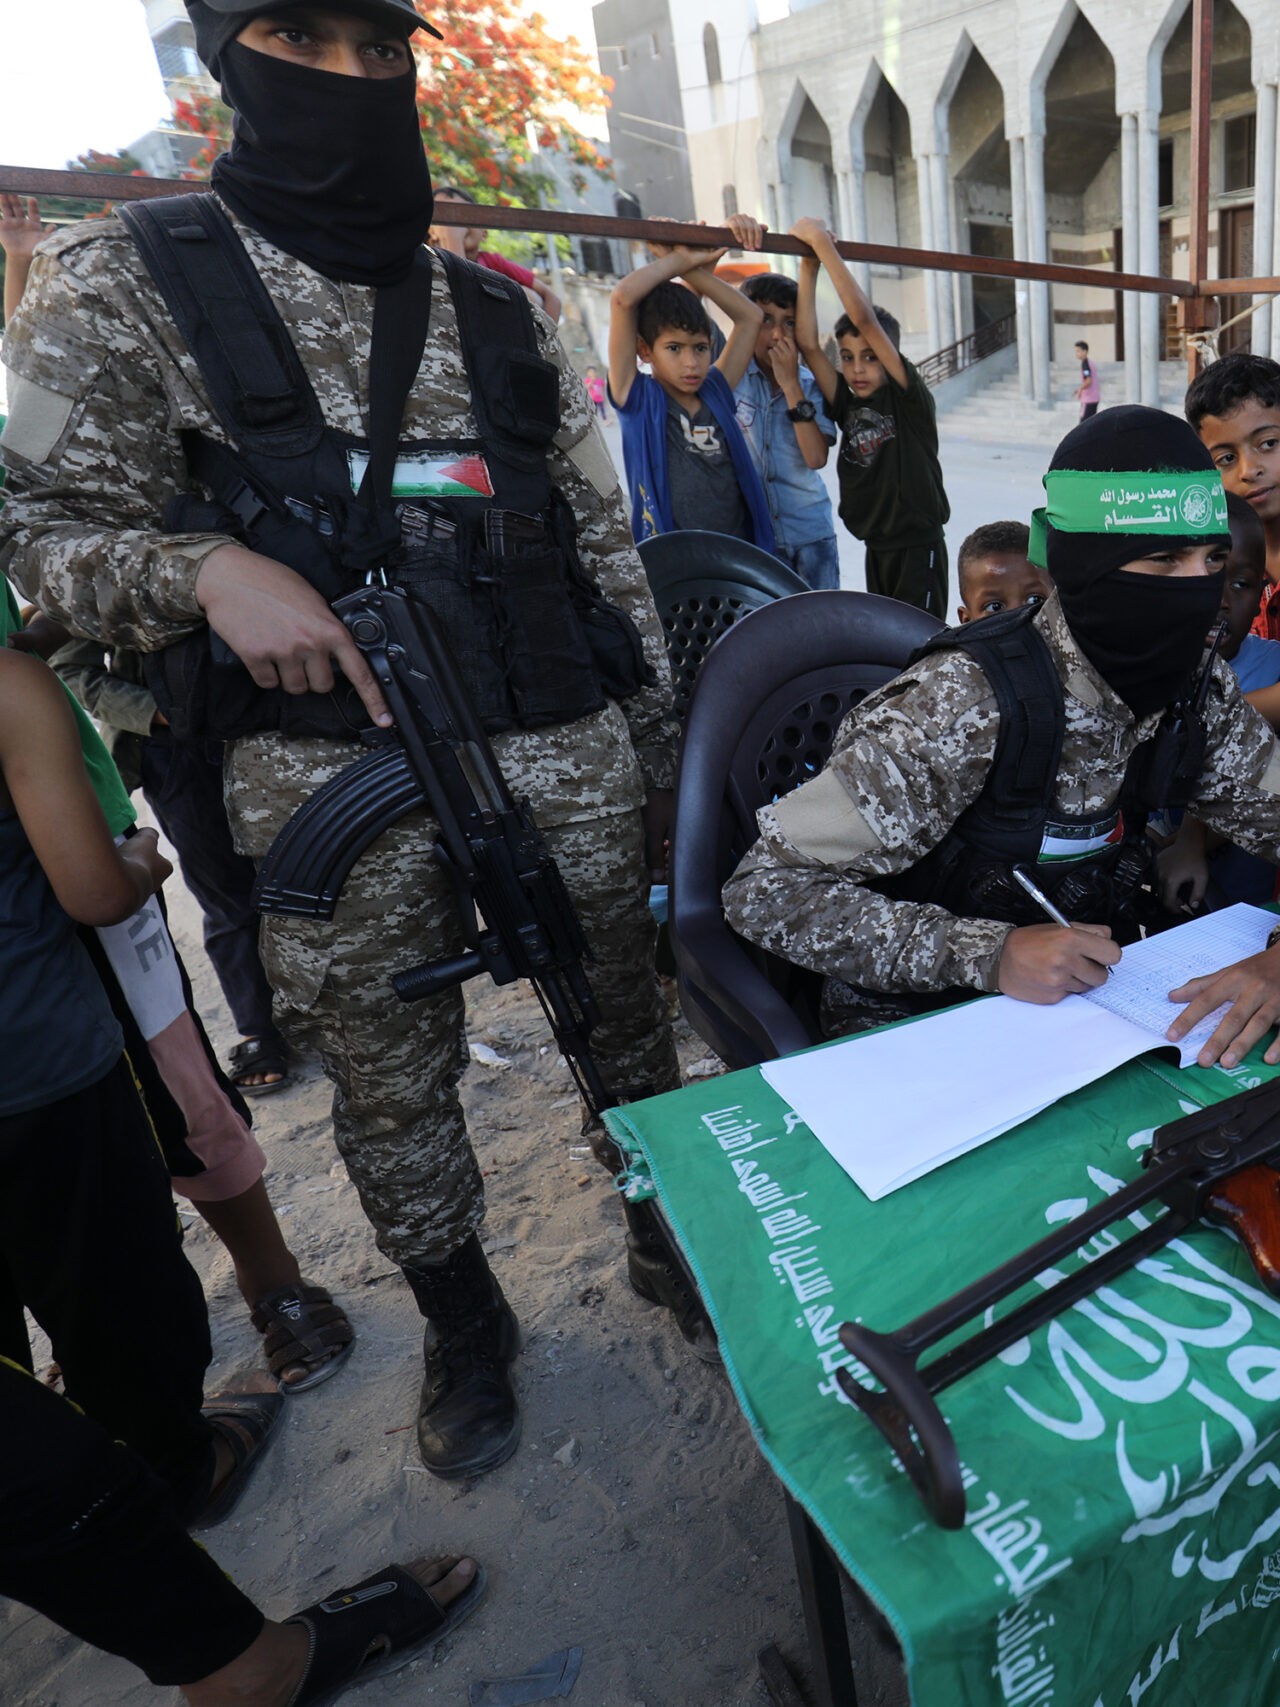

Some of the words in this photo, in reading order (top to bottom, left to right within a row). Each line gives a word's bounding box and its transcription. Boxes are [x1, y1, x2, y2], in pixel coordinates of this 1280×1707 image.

[1099, 488, 1116, 503] الله
[1117, 488, 1145, 506] رسول
[1147, 487, 1177, 500] محمد
[1104, 505, 1178, 531] القسام
[761, 1208, 823, 1246] الله
[767, 1246, 835, 1305] سبيل
